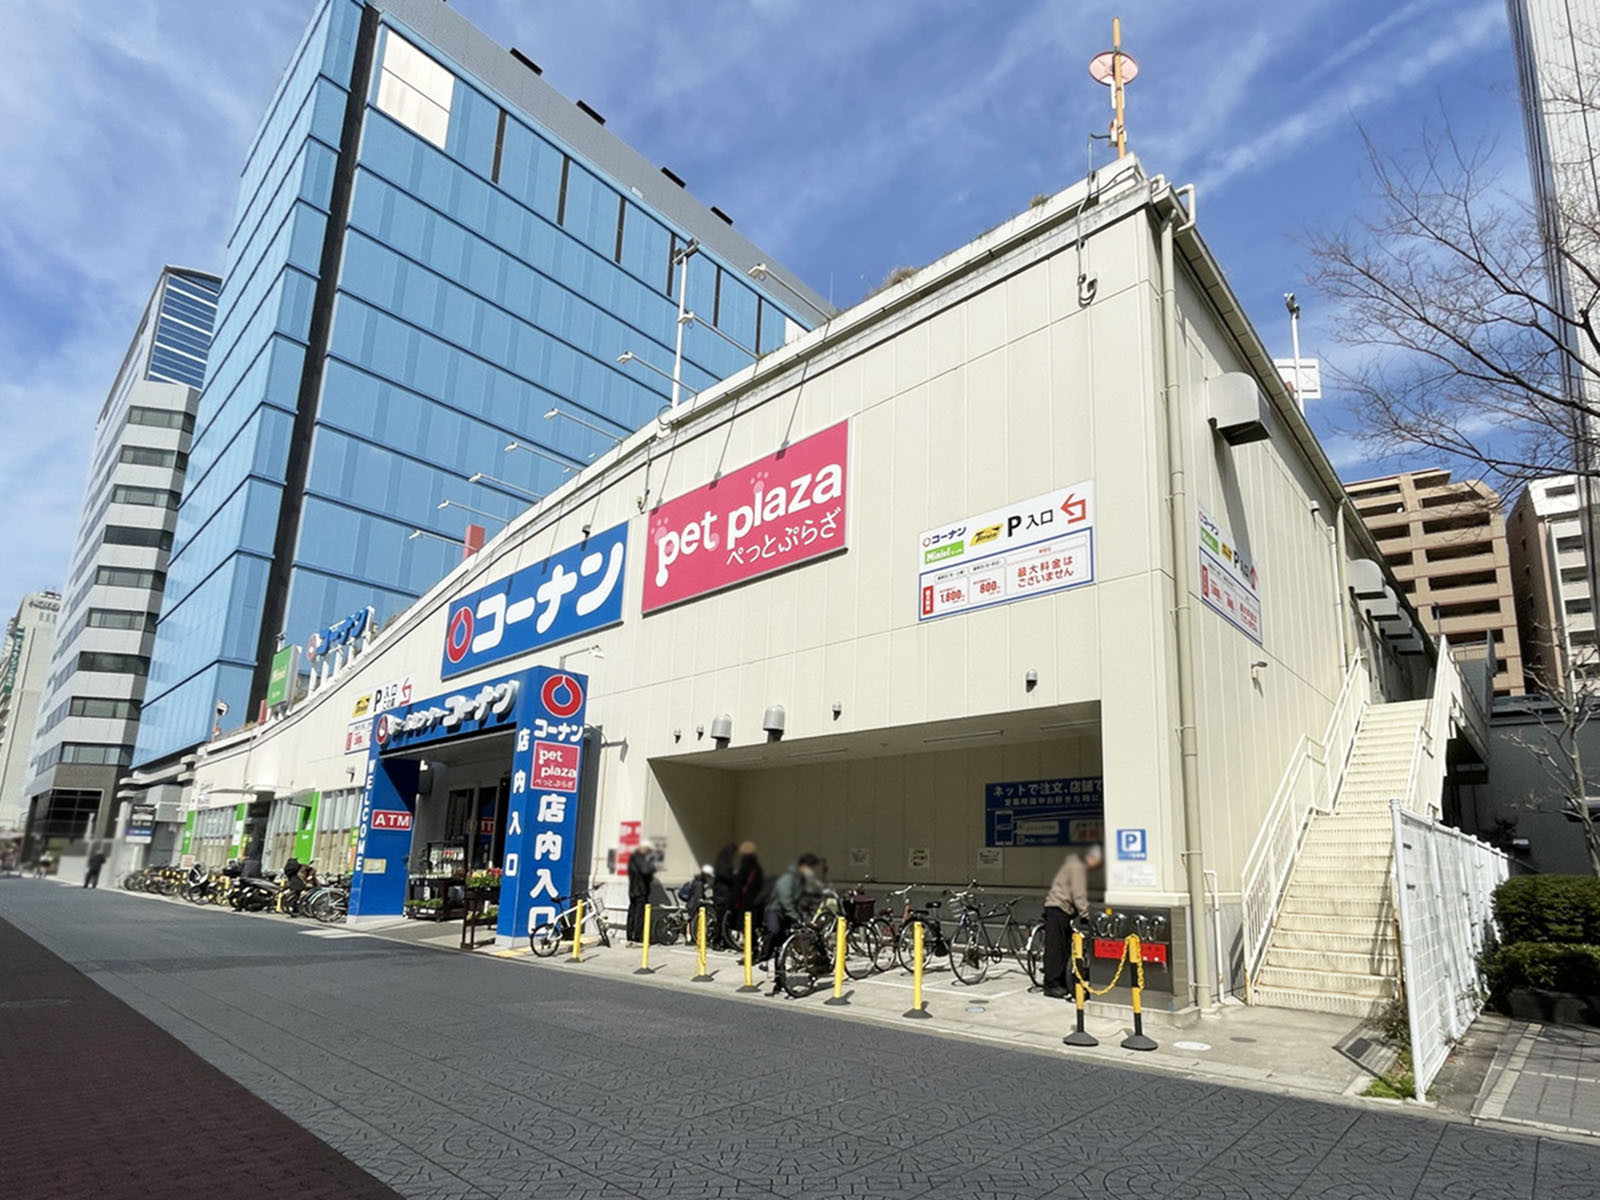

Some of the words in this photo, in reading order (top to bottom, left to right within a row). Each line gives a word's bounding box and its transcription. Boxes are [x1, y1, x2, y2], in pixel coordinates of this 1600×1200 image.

[655, 510, 717, 588] pet
[727, 463, 842, 550] plaza
[932, 526, 967, 544] コーナン
[1007, 515, 1022, 538] P
[1026, 509, 1053, 530] 入口
[725, 506, 842, 567] ぺっとぷらざ
[1017, 556, 1073, 578] 最大料金は
[472, 541, 624, 654] コーナン
[979, 581, 997, 595] 800
[374, 690, 382, 712] P
[442, 680, 519, 727] コーナン
[534, 719, 583, 742] コーナン
[538, 748, 564, 765] pet
[541, 765, 577, 778] plaza
[504, 728, 531, 877] 店内入口
[355, 759, 377, 871] WELCOME
[374, 813, 410, 827] ATM
[1125, 834, 1137, 849] P
[527, 793, 567, 935] 店内入口
